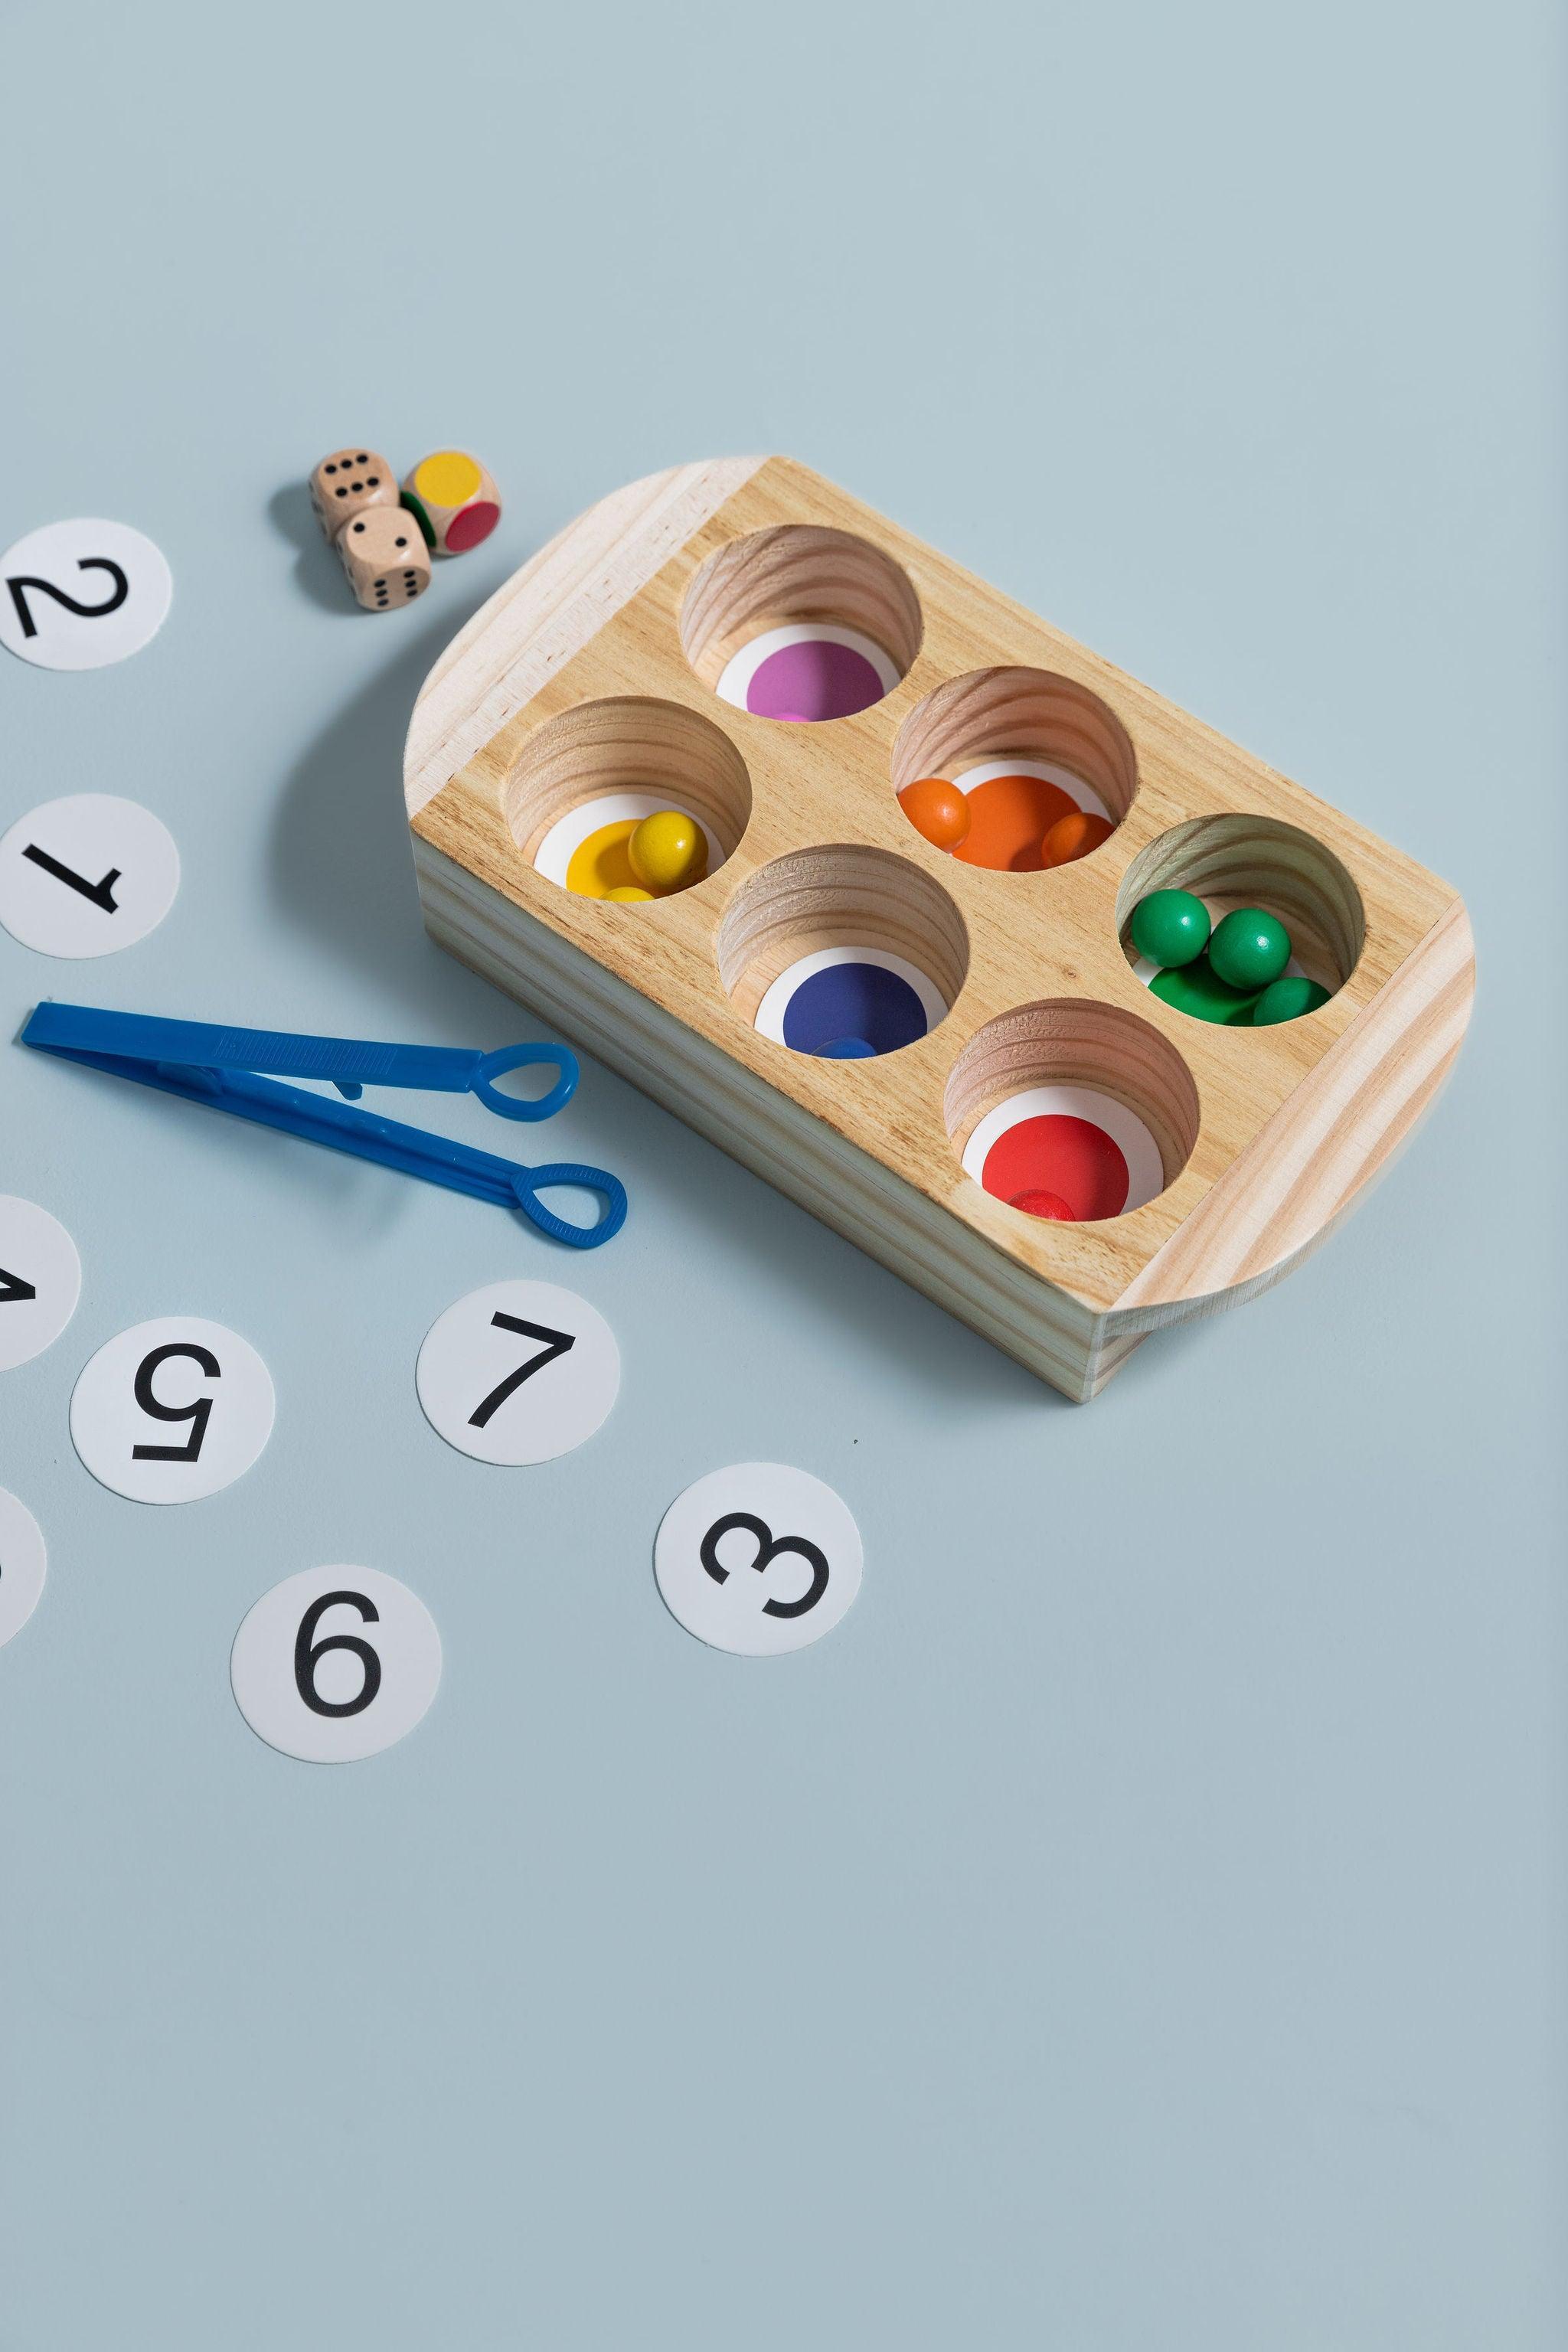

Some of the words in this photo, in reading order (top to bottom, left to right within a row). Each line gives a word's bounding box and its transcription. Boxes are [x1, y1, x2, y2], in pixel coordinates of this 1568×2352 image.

[6, 558, 129, 639] 2
[21, 843, 122, 914] 1
[132, 1343, 222, 1463] 5
[466, 1311, 577, 1429] 7
[699, 1512, 830, 1620] 3
